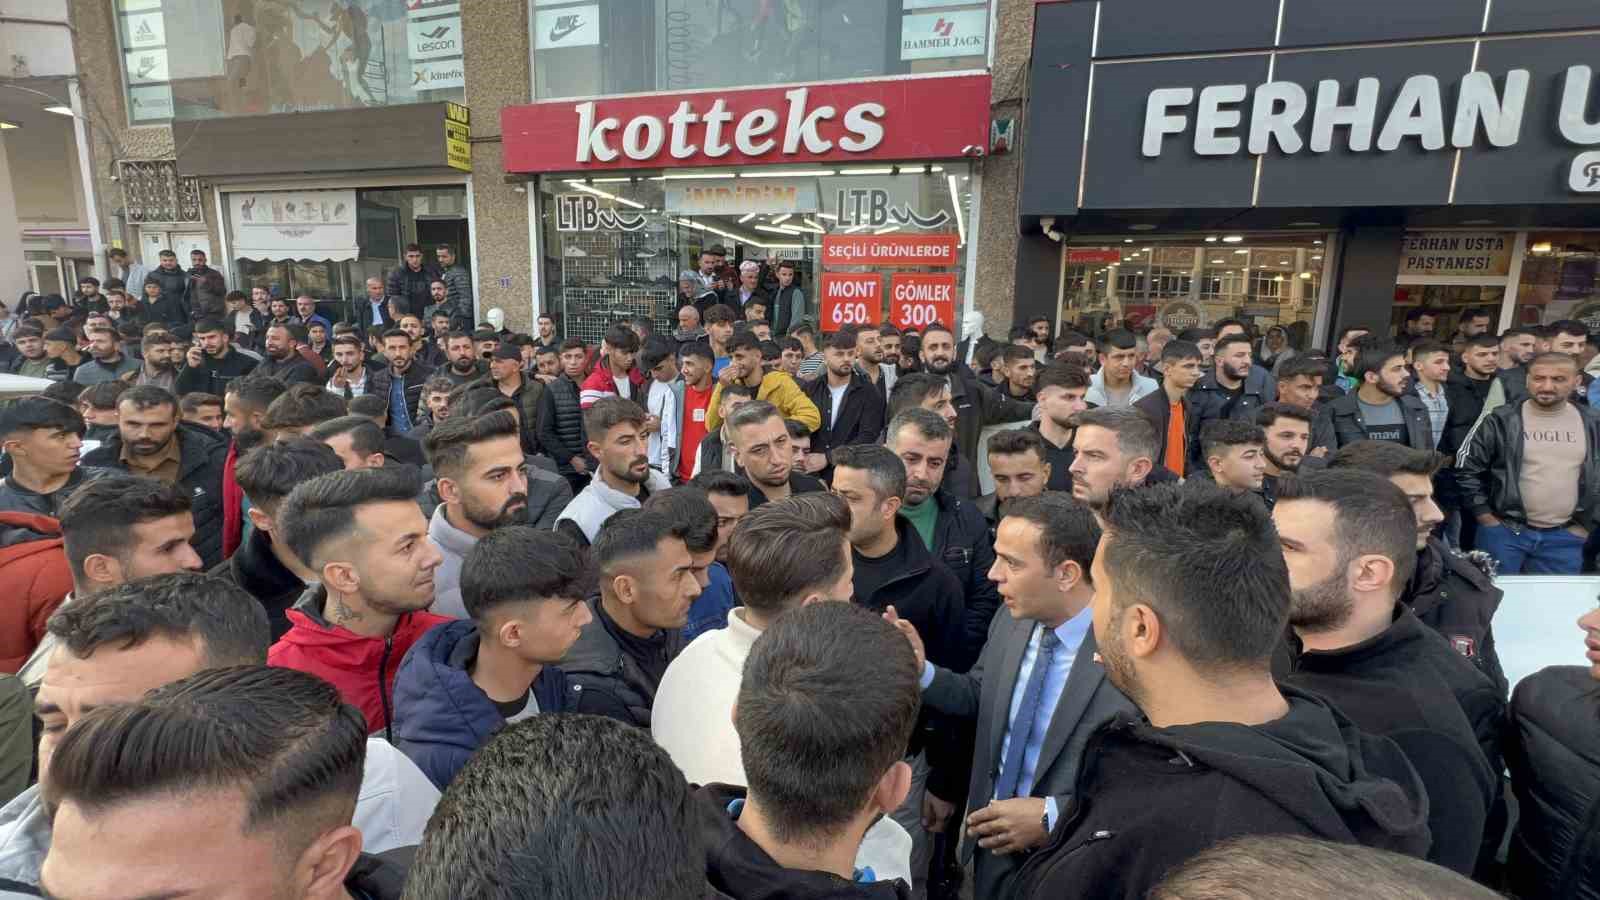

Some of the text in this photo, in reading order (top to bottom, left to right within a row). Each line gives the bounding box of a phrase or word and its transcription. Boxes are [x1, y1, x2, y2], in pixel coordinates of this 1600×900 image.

[555, 15, 581, 30] NIKE
[904, 36, 980, 50] HAMMER JACK
[1142, 69, 1530, 157] FERHAN
[576, 87, 886, 162] kotteks
[556, 194, 599, 231] LTB
[836, 188, 888, 228] LTB
[828, 242, 950, 259] SEÇİLİ ÜRÜNLERDE
[1401, 237, 1504, 250] FERHAN USTA
[828, 281, 877, 298] MONT
[895, 281, 950, 301] GÖMLEK
[1369, 430, 1400, 440] mavi
[1522, 431, 1577, 443] VOGUE
